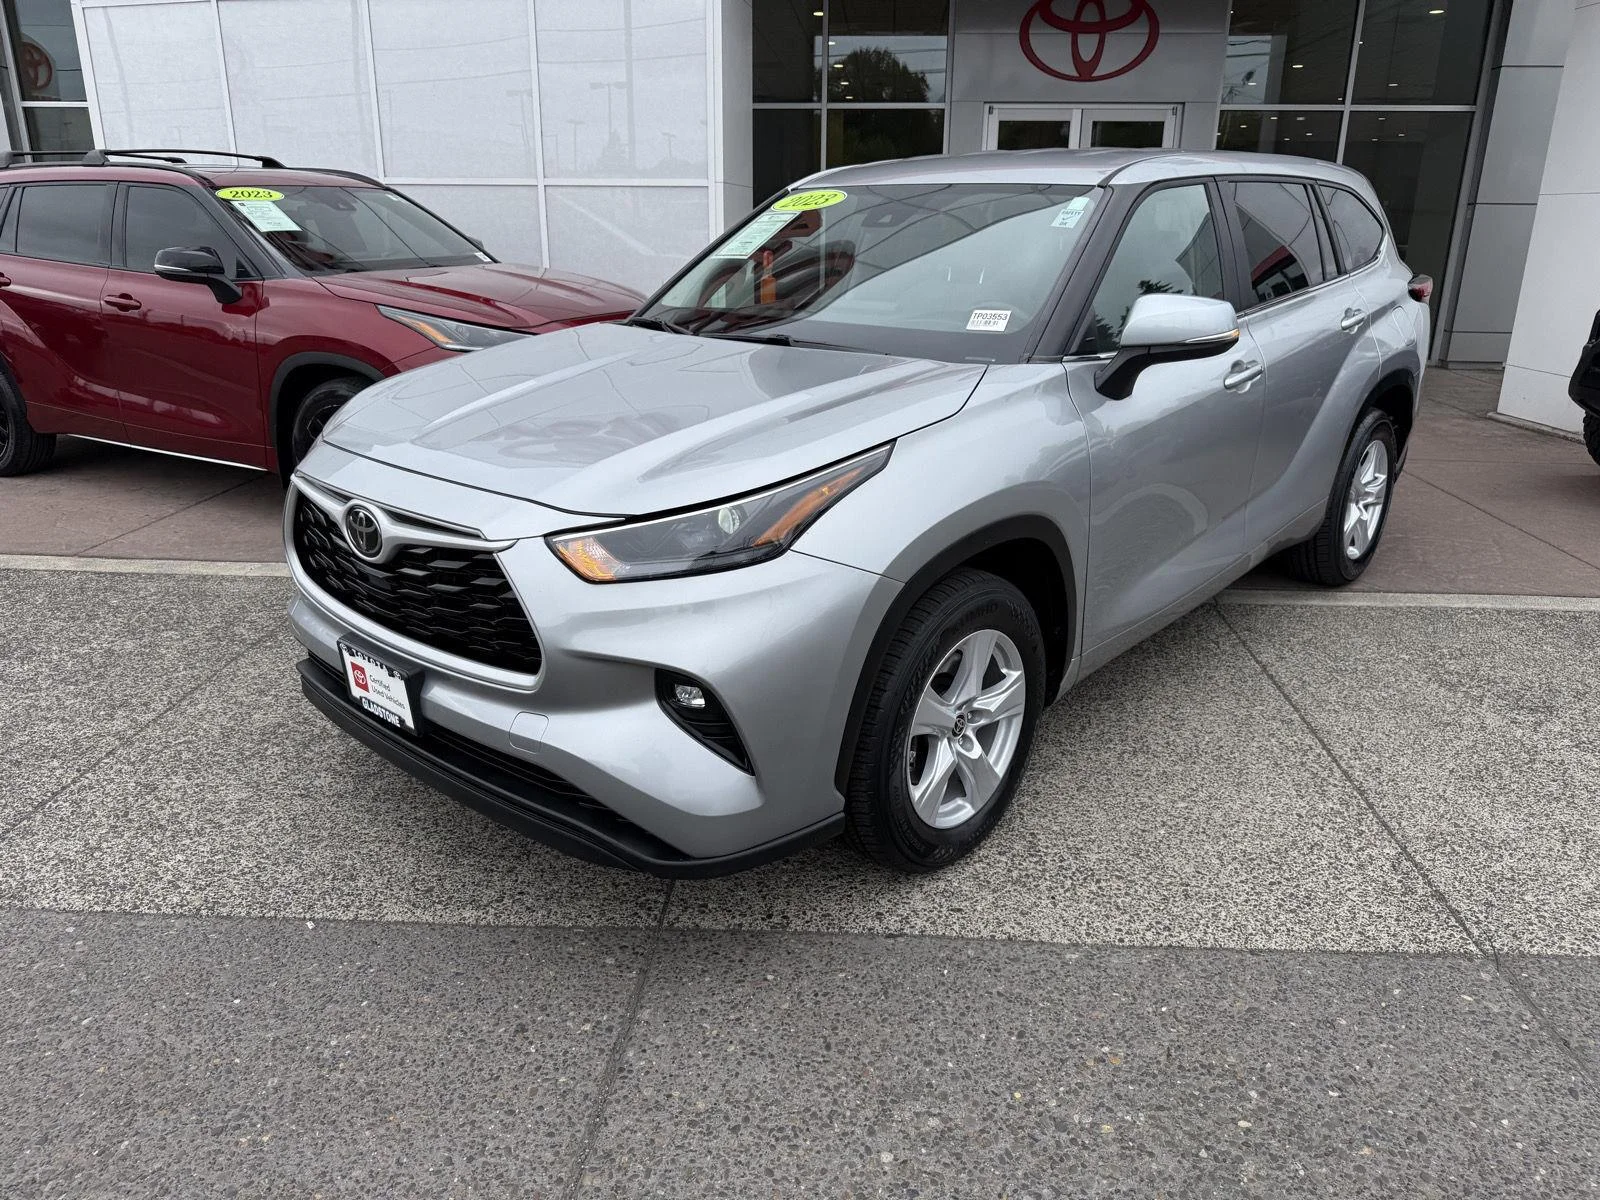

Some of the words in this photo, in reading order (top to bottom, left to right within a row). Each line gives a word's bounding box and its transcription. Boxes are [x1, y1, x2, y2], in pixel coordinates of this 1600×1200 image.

[230, 190, 273, 199] 2023
[780, 193, 838, 207] 2023
[369, 675, 390, 691] Certified
[371, 685, 384, 698] Used
[384, 692, 405, 709] Vehicles
[362, 697, 400, 727] GLADSTONE
